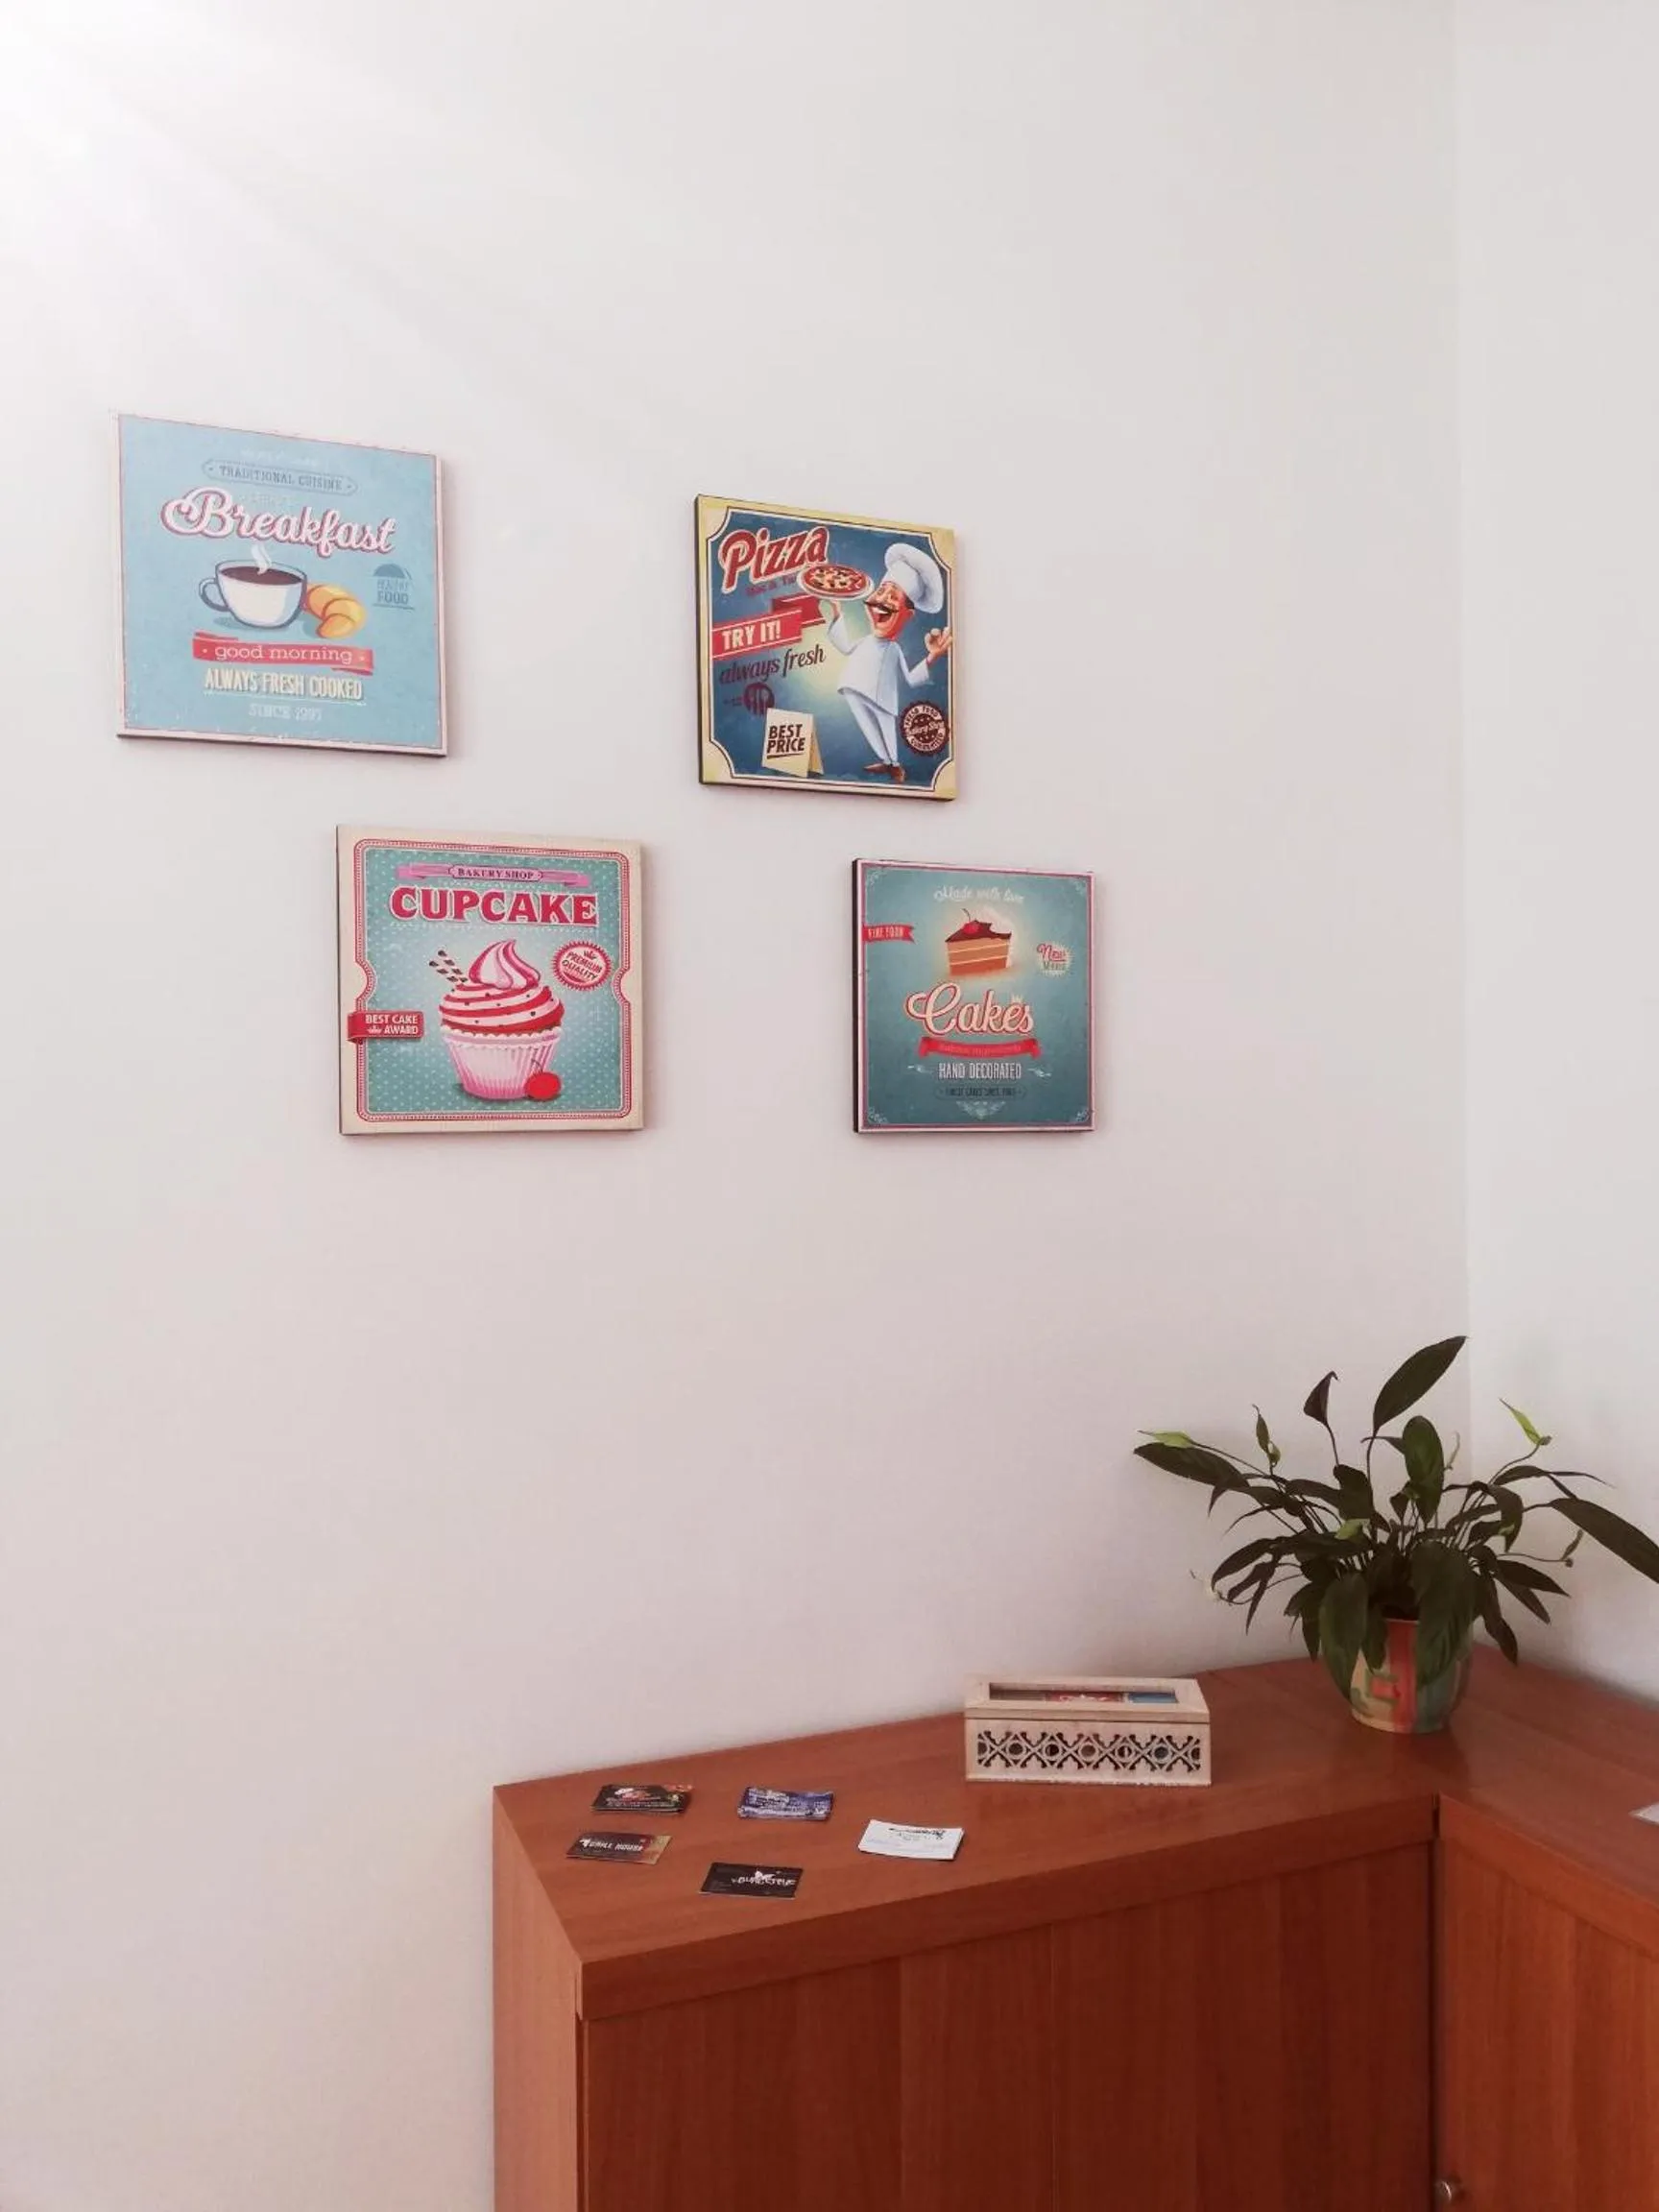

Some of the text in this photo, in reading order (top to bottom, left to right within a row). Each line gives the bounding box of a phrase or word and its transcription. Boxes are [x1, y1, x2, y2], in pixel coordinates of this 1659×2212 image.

[219, 465, 342, 491] TRADITIONAL CUISINE
[161, 487, 397, 557] Breakfast
[720, 527, 829, 593] Pizza
[377, 591, 408, 604] FOOD
[722, 620, 781, 650] TRY IT!
[215, 645, 352, 664] good morning
[719, 644, 826, 684] always fresh
[204, 667, 364, 700] ALWAYS FRESH COOKED
[768, 723, 804, 739] BEST
[766, 737, 805, 754] PRICE
[458, 868, 534, 879] BAKERY SHOP
[391, 886, 598, 925] CUPCAKE
[562, 959, 598, 980] QUALITY
[565, 950, 603, 974] PREMIUM
[365, 1014, 419, 1024] BEST CAKE
[904, 981, 1034, 1036] Cakes
[384, 1024, 419, 1035] AWARD
[939, 1063, 1022, 1080] HAND DECORATED
